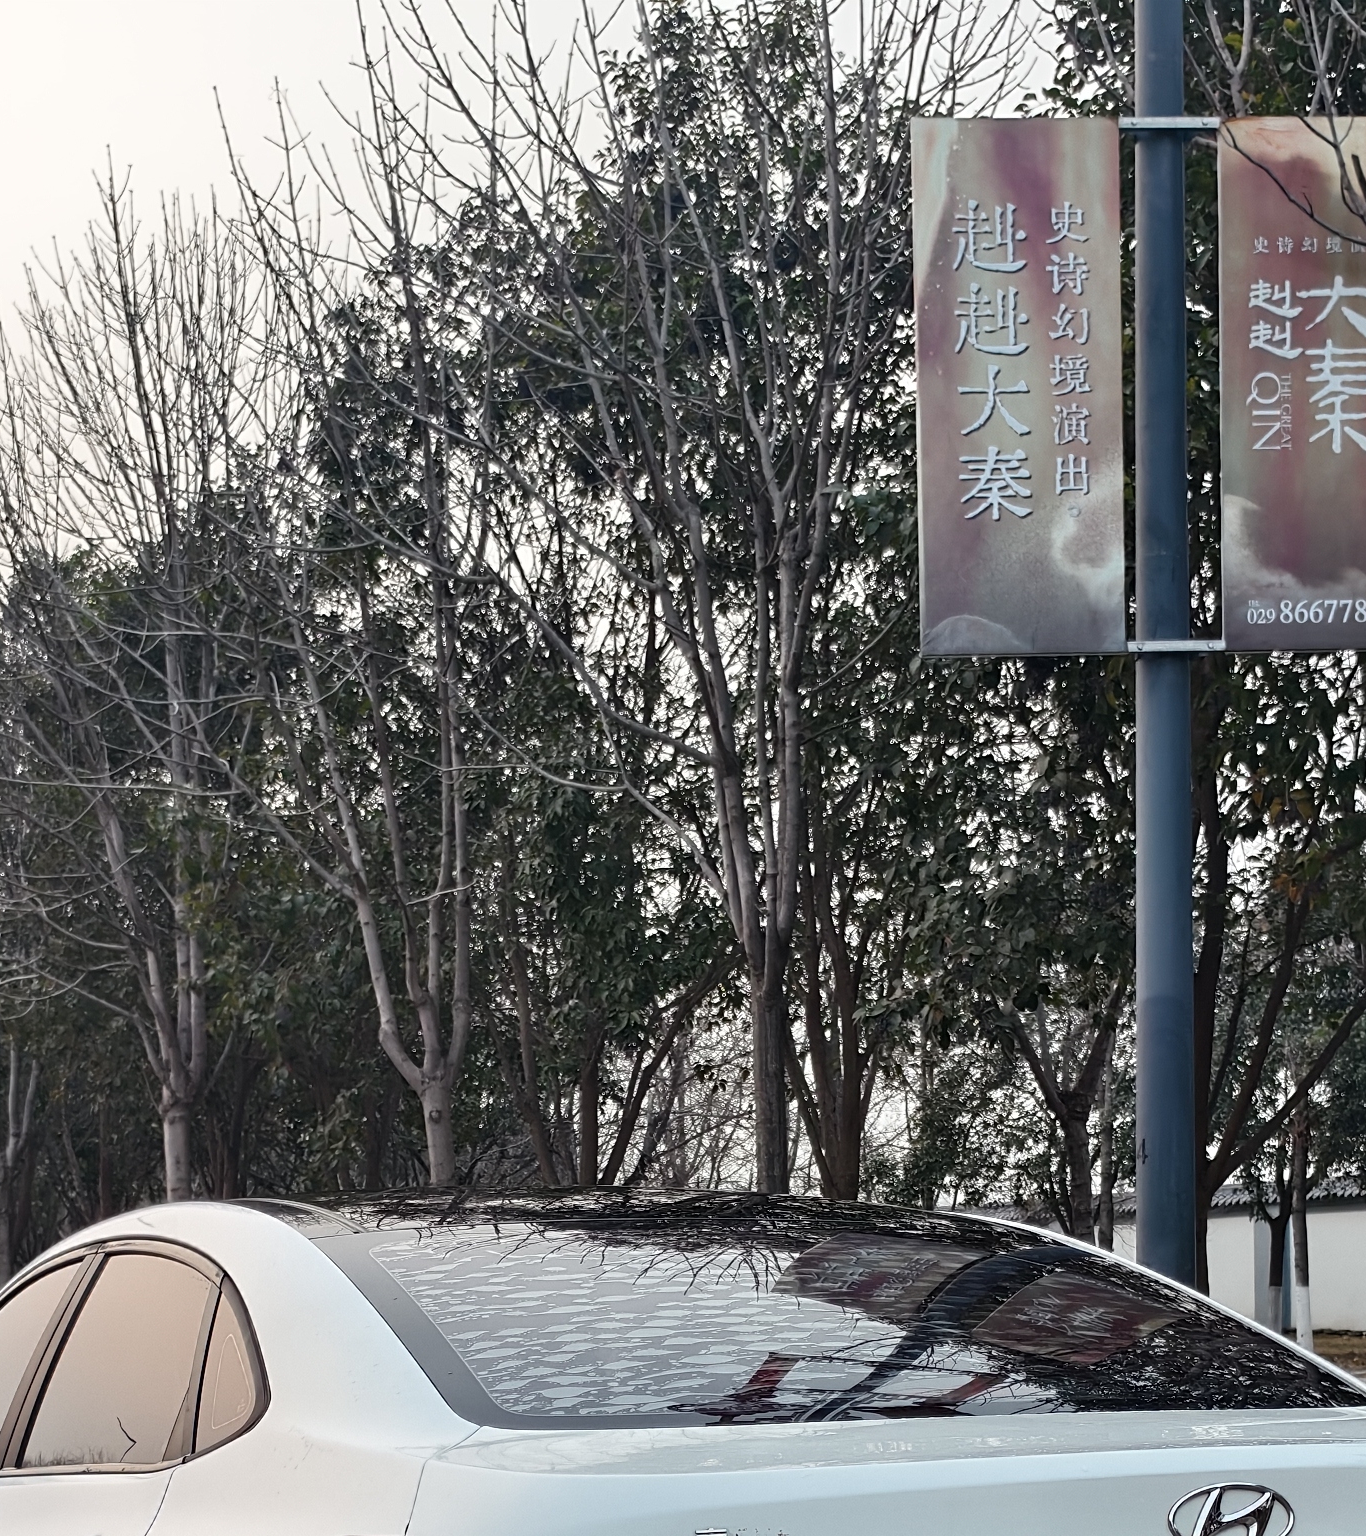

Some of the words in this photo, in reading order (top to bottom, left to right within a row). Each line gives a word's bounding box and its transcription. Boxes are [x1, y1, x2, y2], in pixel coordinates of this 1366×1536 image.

[1045, 201, 1092, 496] 史诗幻境演出
[1248, 279, 1304, 360] 赳赳
[952, 199, 1033, 522] 赳赳大秦
[1280, 372, 1292, 402] THE
[1245, 371, 1281, 451] QIN
[1280, 403, 1292, 451] GREAT
[1247, 608, 1276, 625] 029
